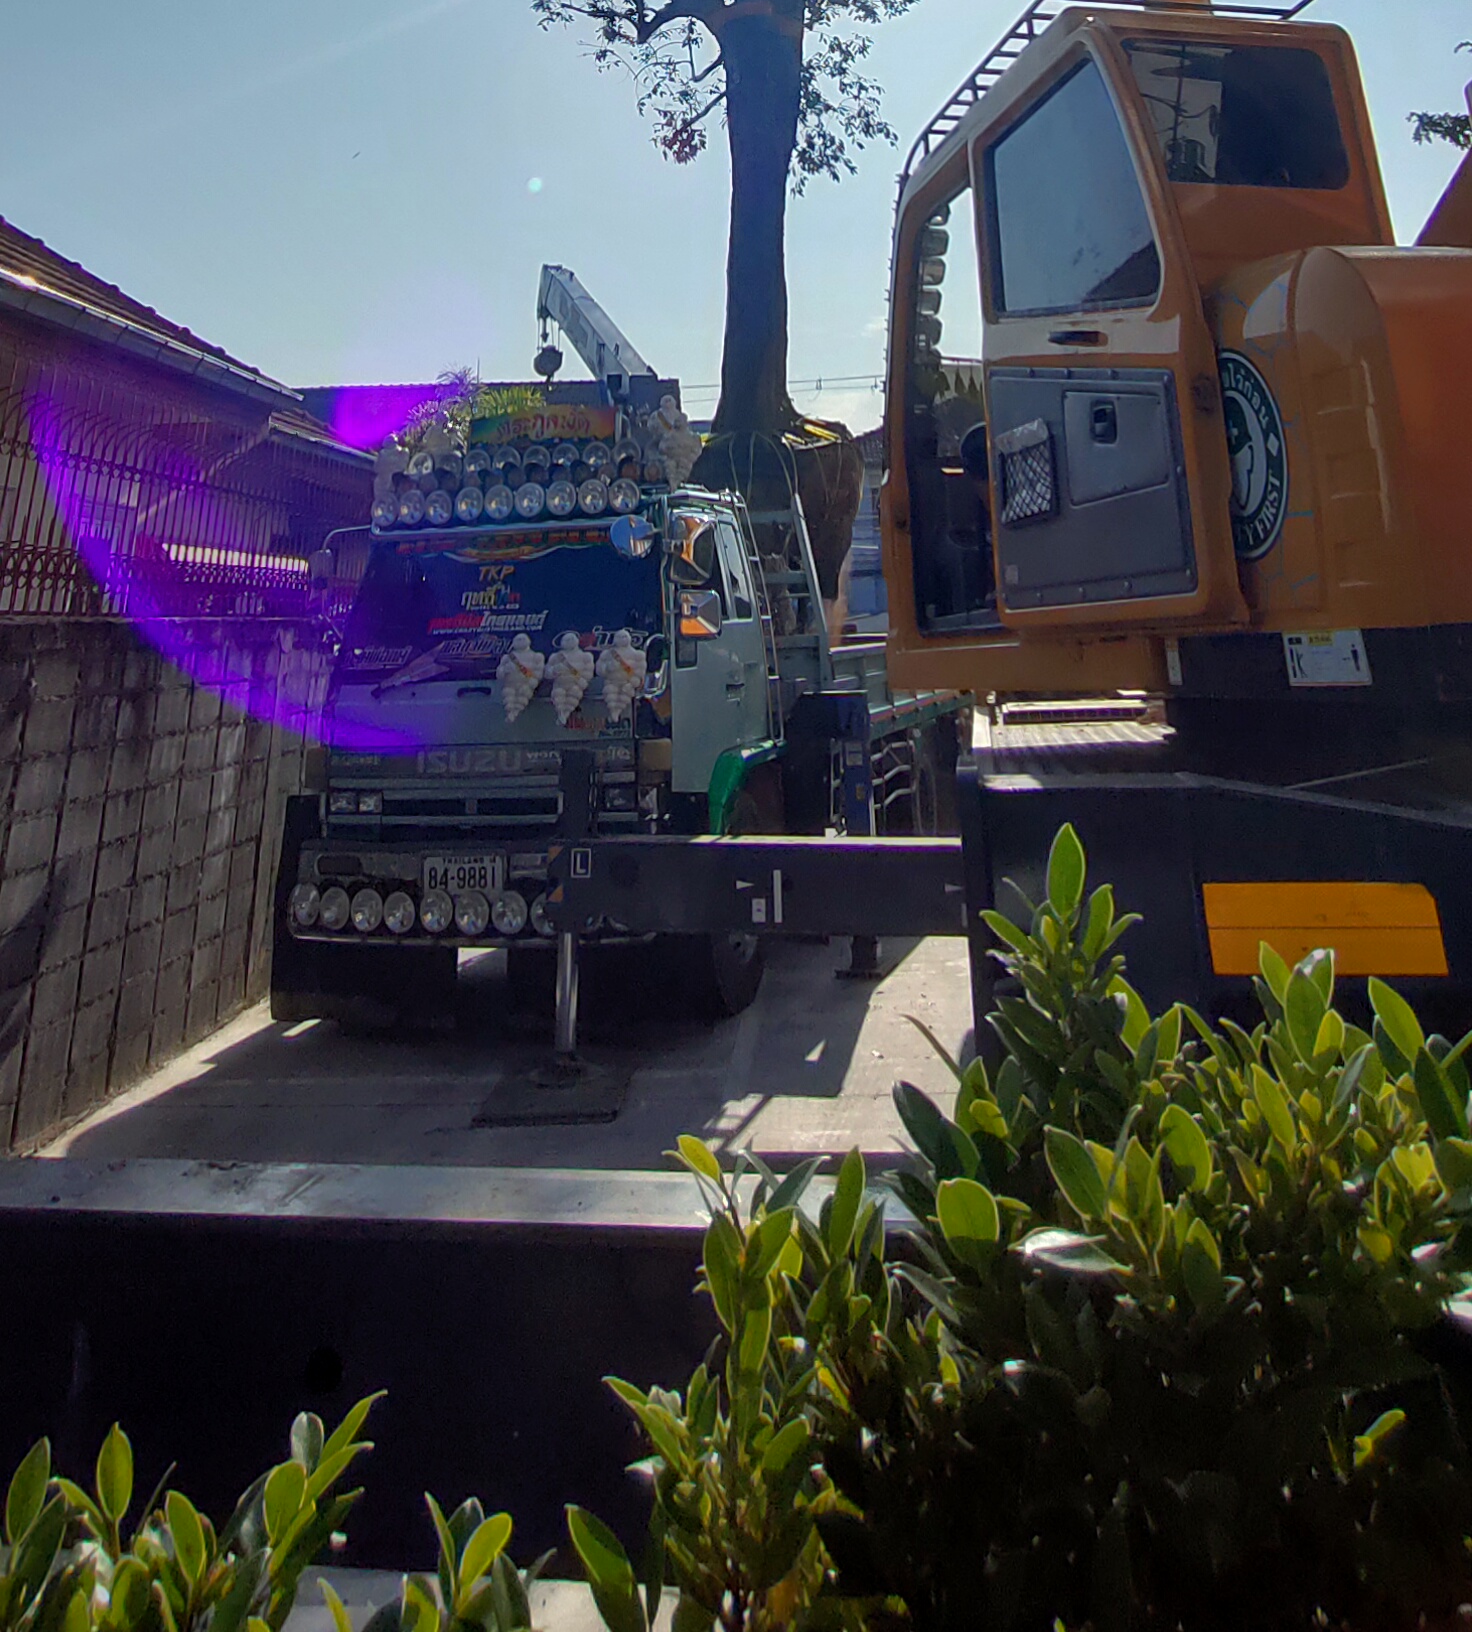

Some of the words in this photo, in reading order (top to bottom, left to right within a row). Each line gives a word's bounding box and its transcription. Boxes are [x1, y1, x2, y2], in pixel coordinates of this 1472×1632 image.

[1255, 469, 1280, 540] FIRST
[479, 565, 515, 581] TKP
[417, 746, 521, 774] ISUZU
[443, 857, 484, 865] THAILAND
[428, 866, 495, 890] 84-9881
